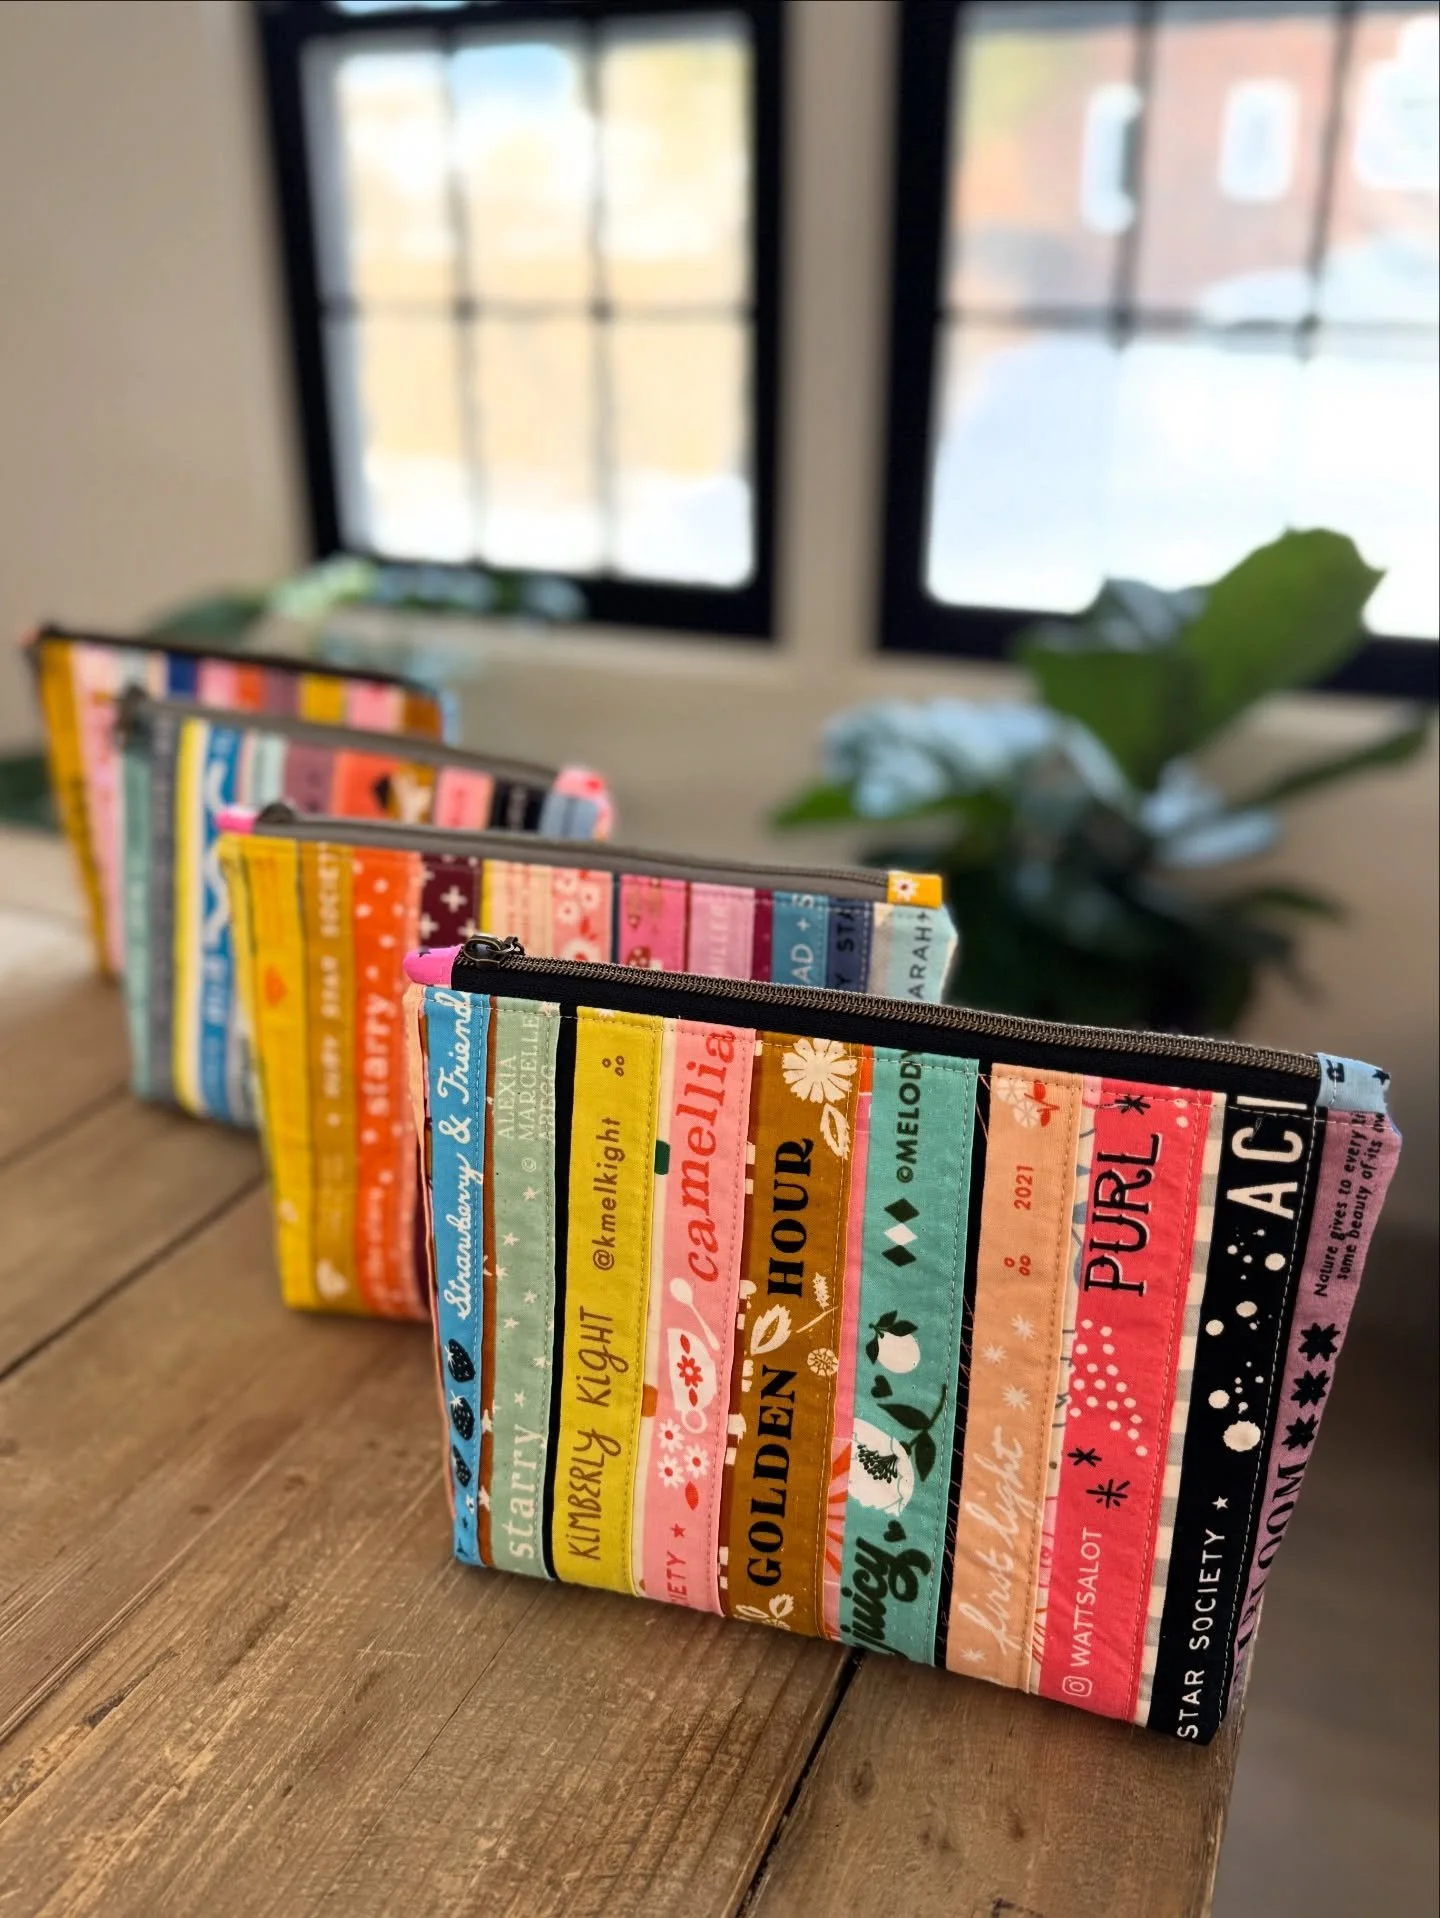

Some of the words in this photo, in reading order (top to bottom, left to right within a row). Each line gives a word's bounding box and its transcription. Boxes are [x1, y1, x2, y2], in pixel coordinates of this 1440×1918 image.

[836, 897, 856, 953] STA
[363, 993, 396, 1116] starry
[497, 1056, 517, 1140] ALEXIA
[518, 1015, 540, 1142] MARCELLE
[439, 1111, 473, 1144] &
[676, 1031, 735, 1283] camellia
[1343, 1130, 1366, 1172] every
[1360, 1160, 1376, 1179] of
[1363, 1140, 1382, 1159] its
[442, 1154, 483, 1320] Strawberry
[593, 1117, 625, 1272] @kmelkight
[767, 1137, 814, 1298] HOUR
[1013, 1164, 1034, 1211] 2021
[1084, 1134, 1162, 1299] PURL
[1328, 1202, 1349, 1240] gives
[1338, 1180, 1351, 1195] to
[1347, 1185, 1373, 1239] beauty
[1313, 1246, 1338, 1297] Nature
[1336, 1245, 1356, 1280] some
[502, 1424, 546, 1559] starry
[747, 1364, 797, 1586] GOLDEN
[965, 1425, 1039, 1541] light
[665, 1551, 687, 1606] IETY
[840, 1537, 931, 1660] juicy
[961, 1541, 1021, 1656] first
[1070, 1526, 1102, 1667] WATTSALOT
[1189, 1529, 1226, 1650] SOCIETY
[1177, 1668, 1206, 1740] STAR
